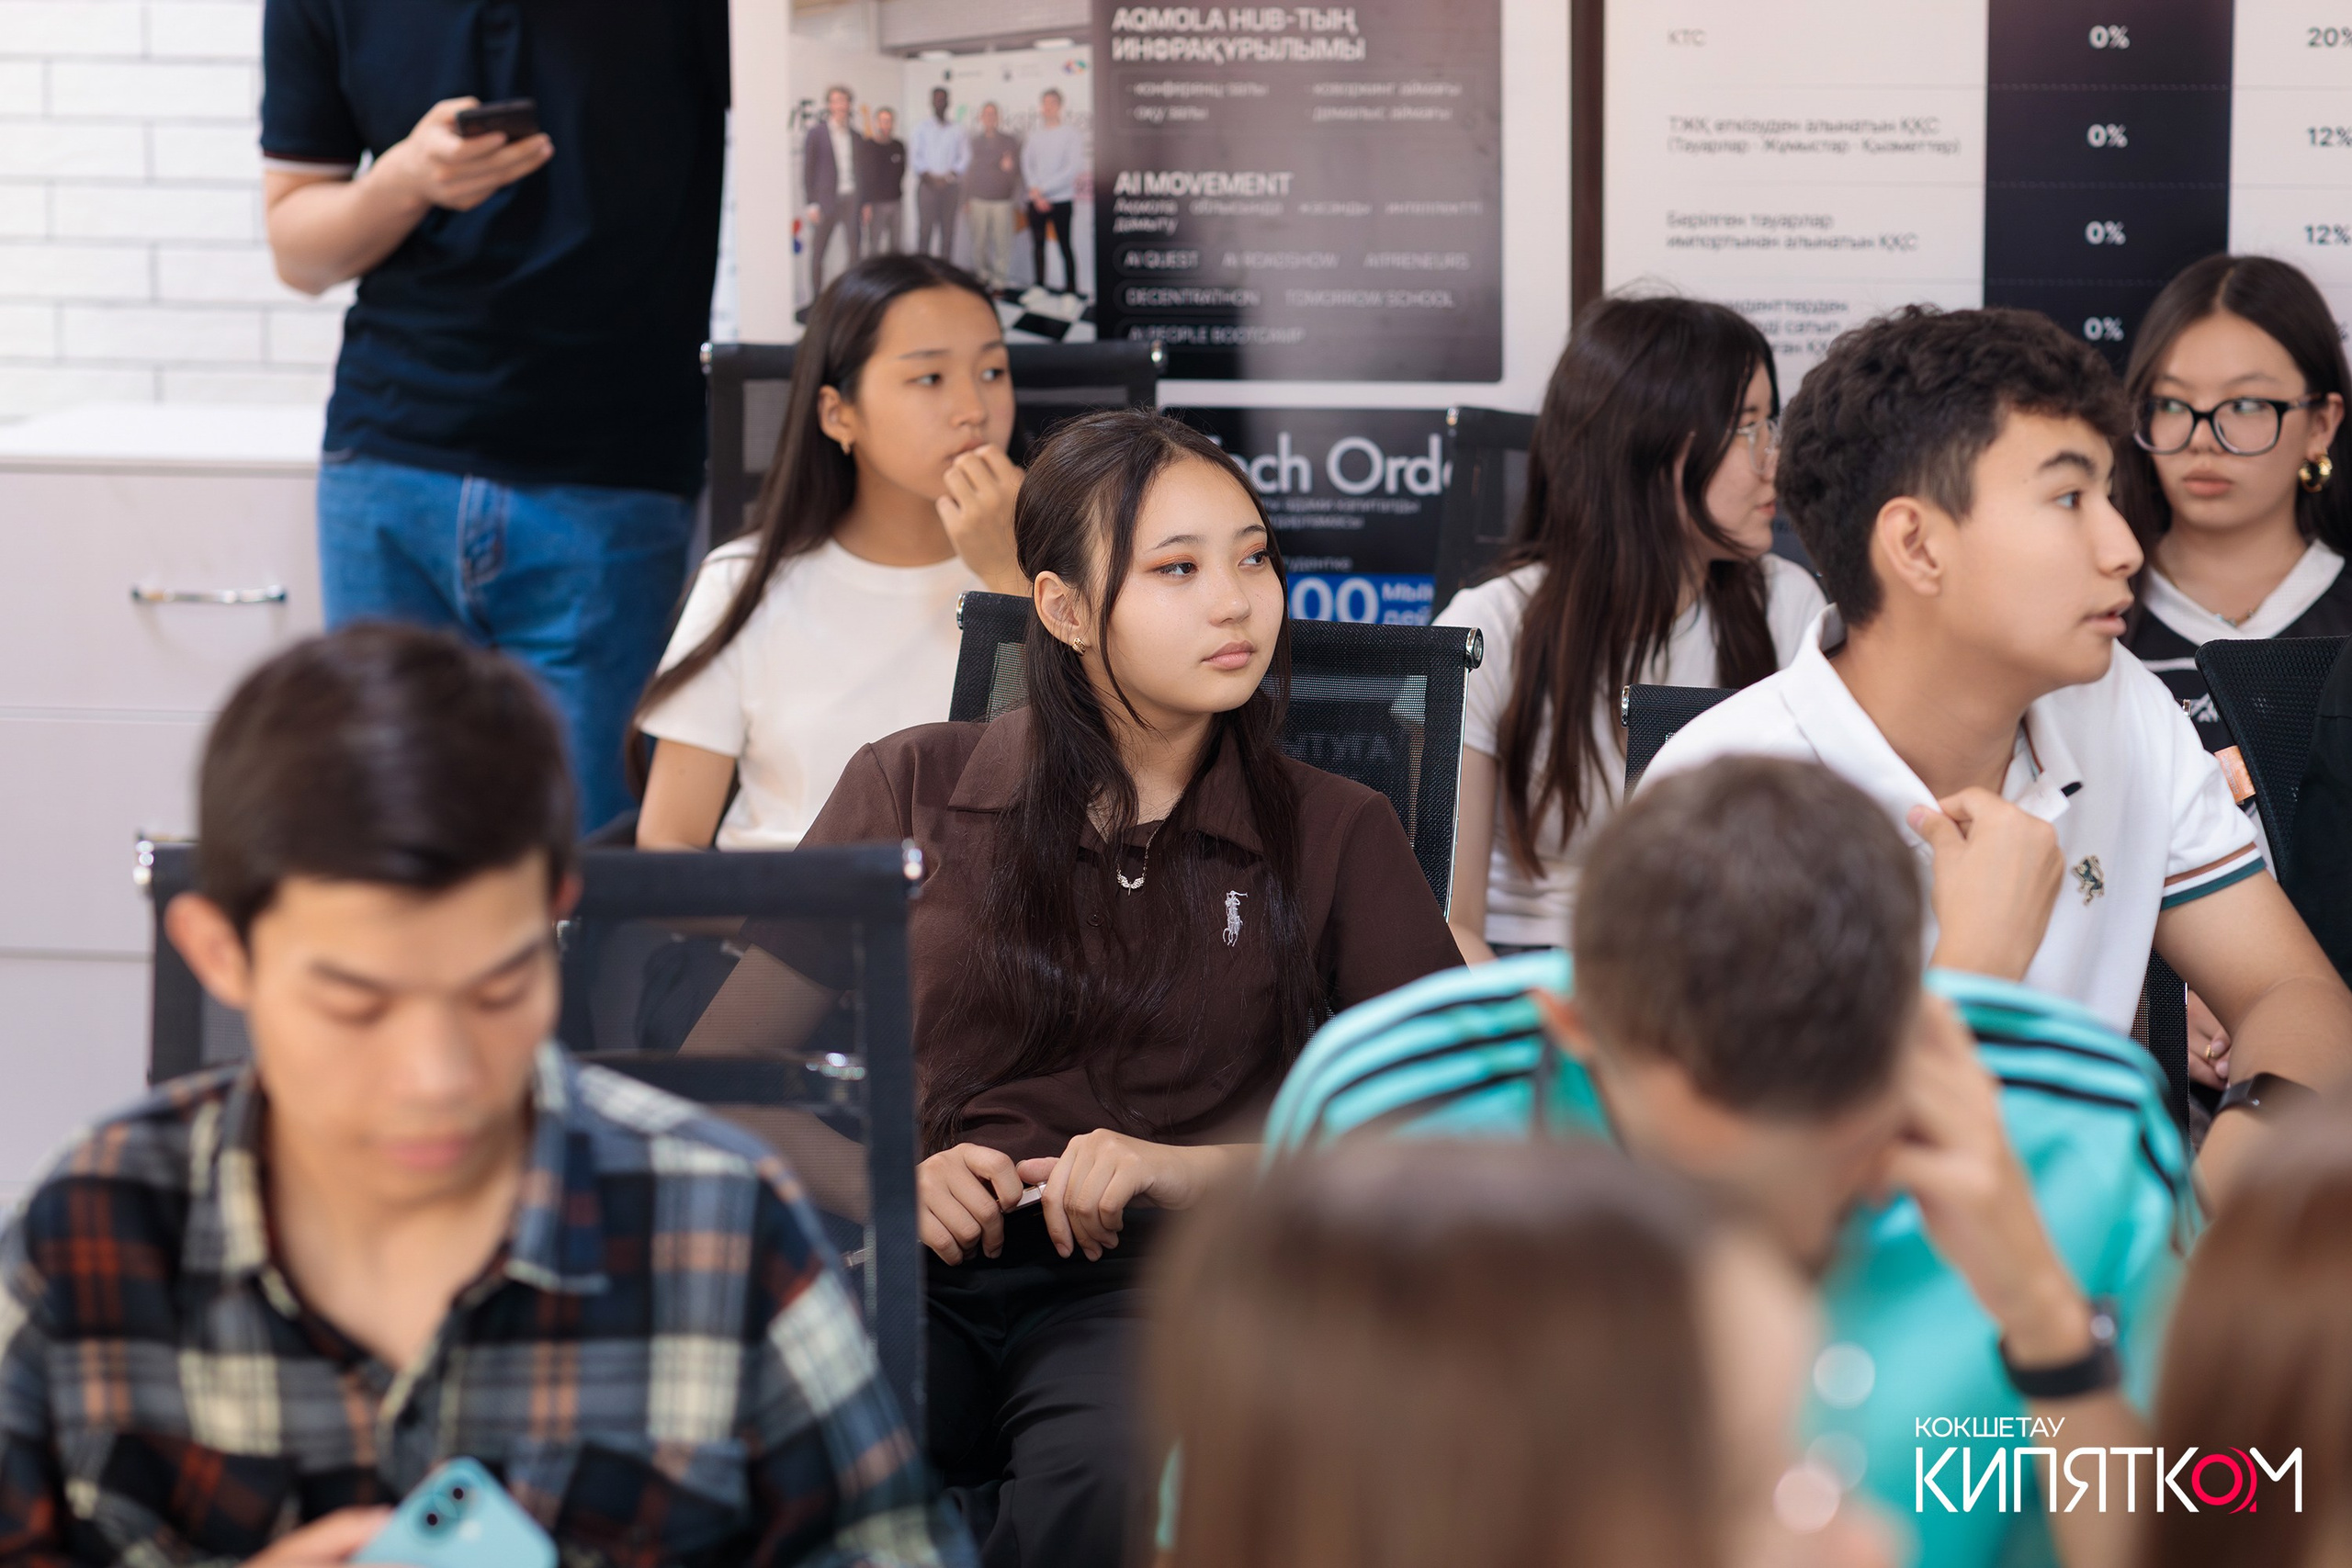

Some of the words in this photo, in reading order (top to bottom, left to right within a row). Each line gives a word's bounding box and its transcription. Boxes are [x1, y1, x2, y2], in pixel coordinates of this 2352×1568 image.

[1112, 7, 1227, 33] AQMOLA
[2089, 25, 2130, 50] 0%
[2087, 124, 2128, 148] 0%
[2307, 127, 2352, 147] 12%
[1114, 172, 1141, 197] AI
[1145, 171, 1294, 196] MOVEMENT
[2086, 220, 2126, 244] 0%
[2304, 225, 2352, 245] 12%
[1143, 250, 1199, 269] QUEST
[2084, 317, 2124, 341] 0%
[1327, 432, 1453, 495] Ord
